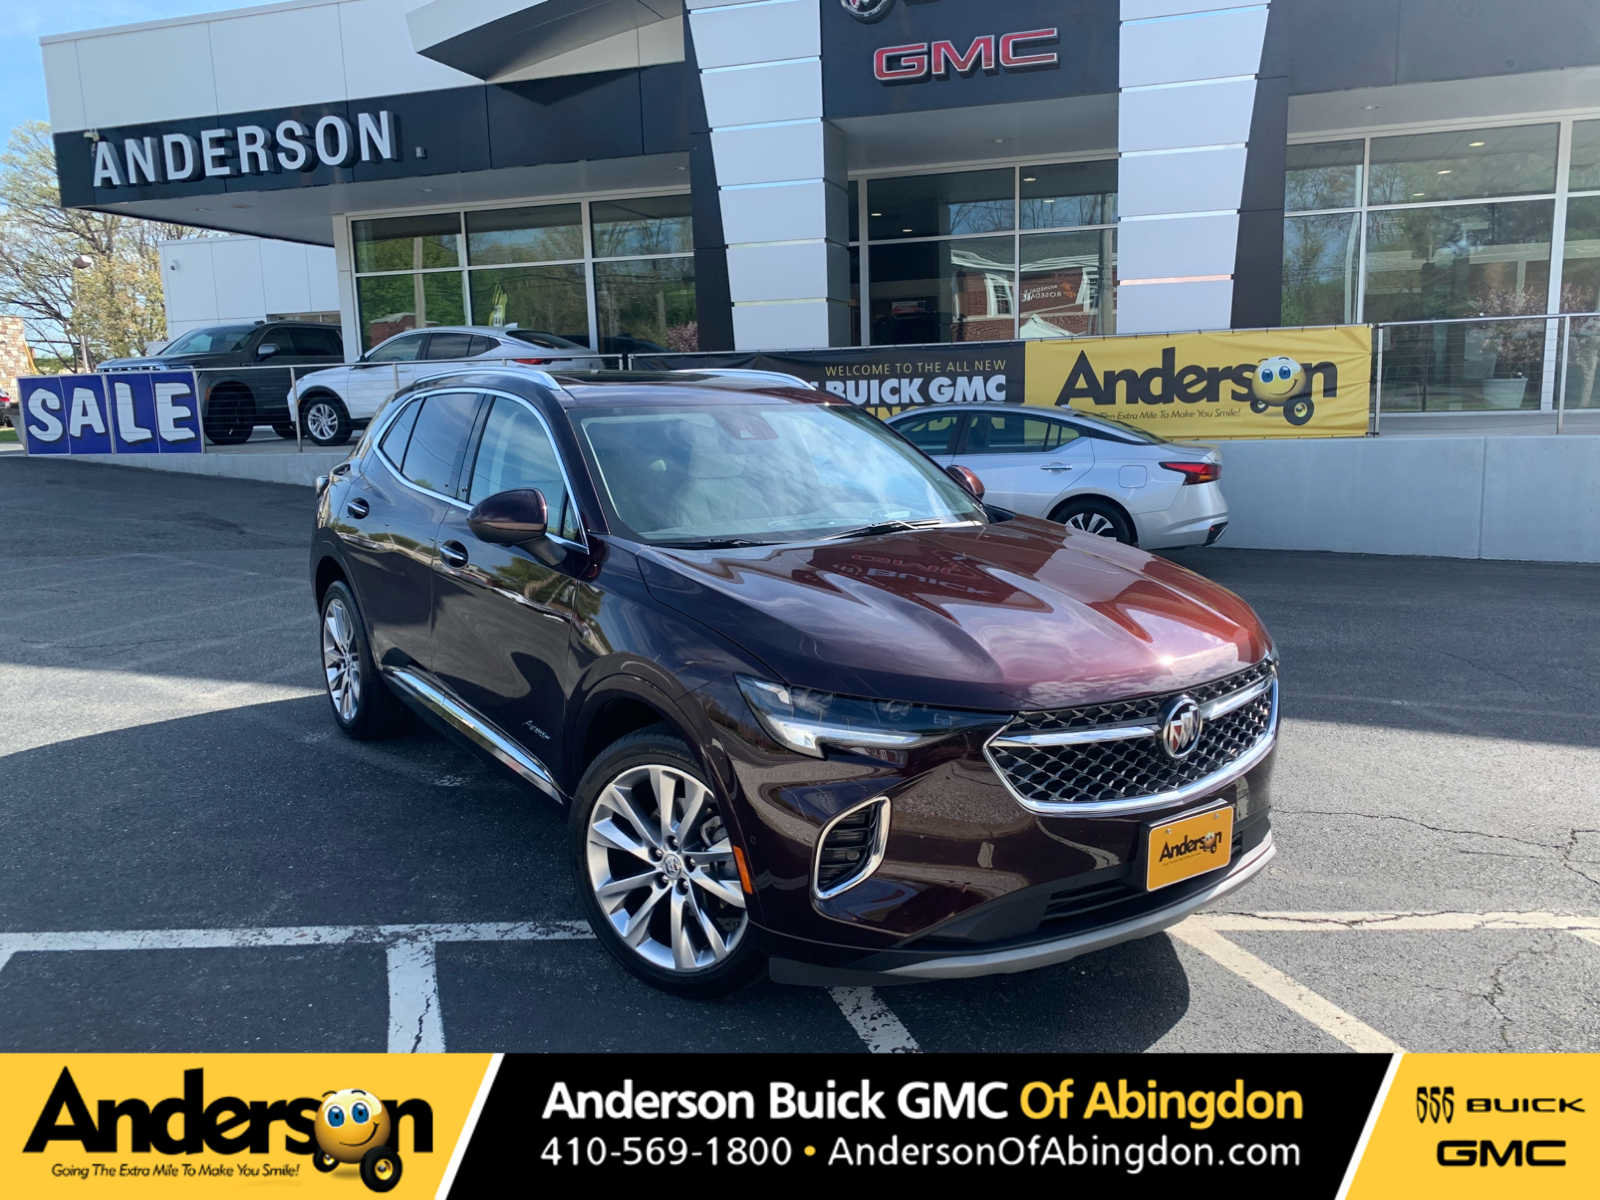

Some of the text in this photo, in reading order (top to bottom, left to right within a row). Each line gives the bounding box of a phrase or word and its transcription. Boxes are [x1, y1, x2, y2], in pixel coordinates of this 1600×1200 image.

[874, 28, 1057, 81] GMC
[93, 110, 393, 187] ANDERSON
[825, 359, 1006, 377] WELCOME TO THE ALL NEW
[928, 374, 1006, 403] GMC
[28, 382, 196, 443] SALE
[1160, 409, 1169, 418] To
[1171, 408, 1195, 418] Make
[1197, 407, 1213, 416] You
